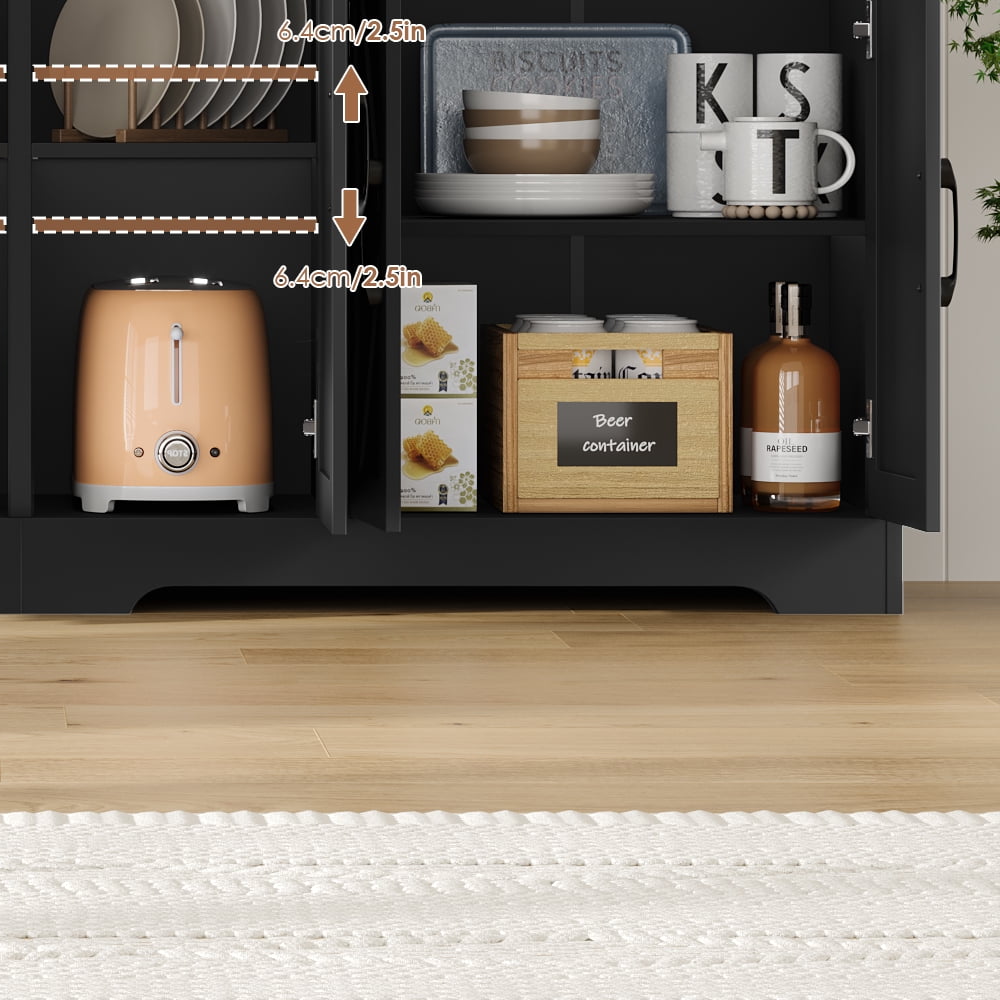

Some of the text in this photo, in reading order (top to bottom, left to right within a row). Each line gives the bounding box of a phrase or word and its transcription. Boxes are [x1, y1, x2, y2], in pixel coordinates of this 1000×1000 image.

[695, 62, 729, 124] K
[778, 61, 811, 123] S
[756, 129, 800, 195] T
[592, 413, 633, 428] Beer
[582, 438, 657, 453] container
[766, 444, 808, 453] RAPESEED
